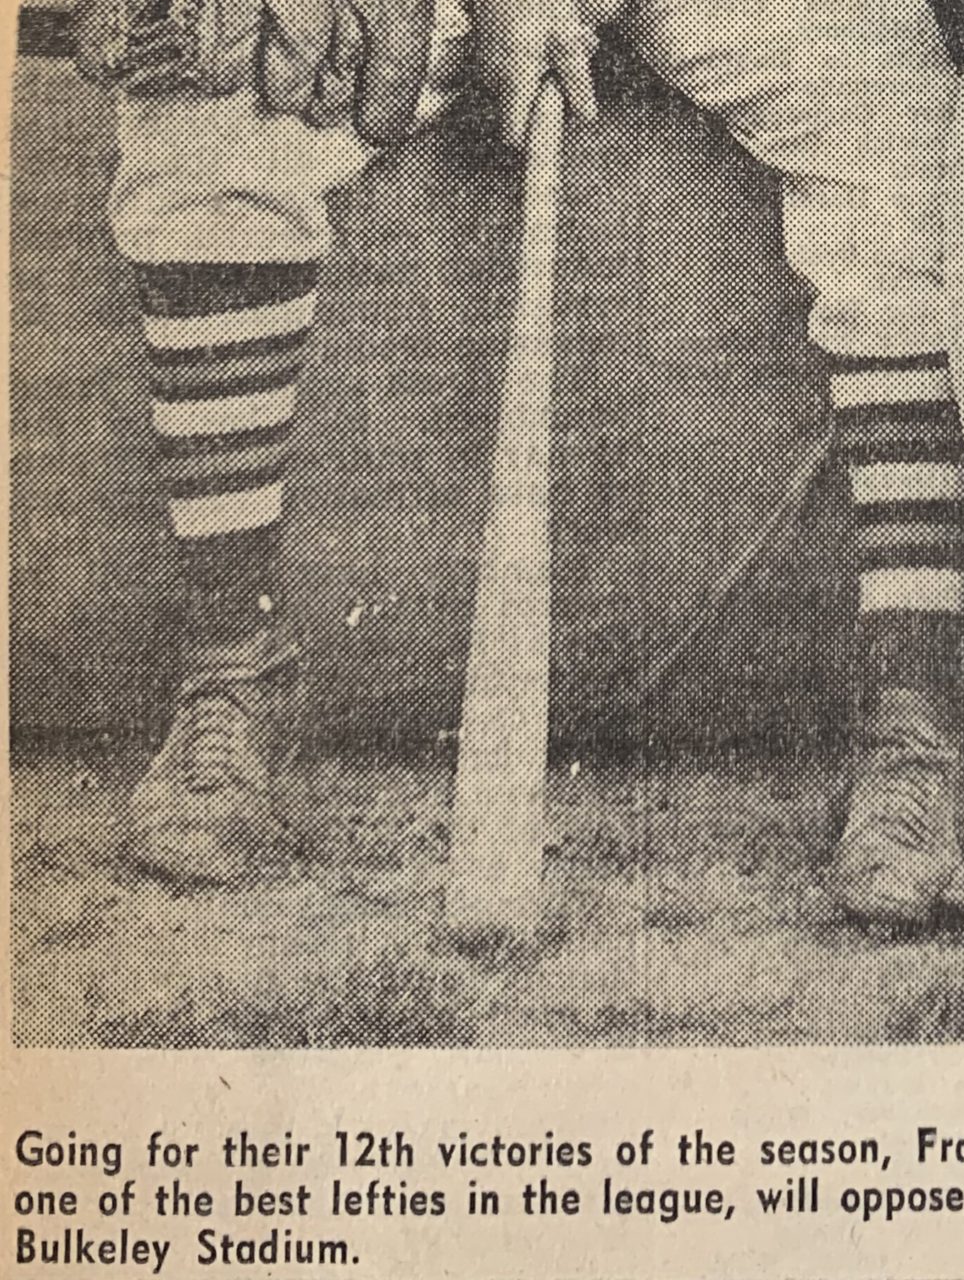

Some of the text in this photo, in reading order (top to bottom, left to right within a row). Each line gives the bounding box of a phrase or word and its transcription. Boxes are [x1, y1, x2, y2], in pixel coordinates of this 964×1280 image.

[16, 1130, 122, 1175] Going
[147, 1131, 199, 1167] for
[223, 1131, 310, 1167] their
[335, 1131, 413, 1167] 12th
[438, 1131, 592, 1167] victories
[616, 1129, 654, 1166] of
[678, 1129, 735, 1166] the
[761, 1140, 891, 1169] season,
[14, 1191, 77, 1215] one
[98, 1180, 136, 1216] of
[155, 1180, 213, 1216] the
[235, 1180, 311, 1216] best
[332, 1180, 446, 1216] lefties
[468, 1180, 499, 1215] in
[522, 1178, 580, 1215] the
[603, 1177, 735, 1224] league,
[756, 1177, 818, 1213] will
[840, 1187, 964, 1222] oppose
[16, 1228, 359, 1274] Bulkeley Stadium.
